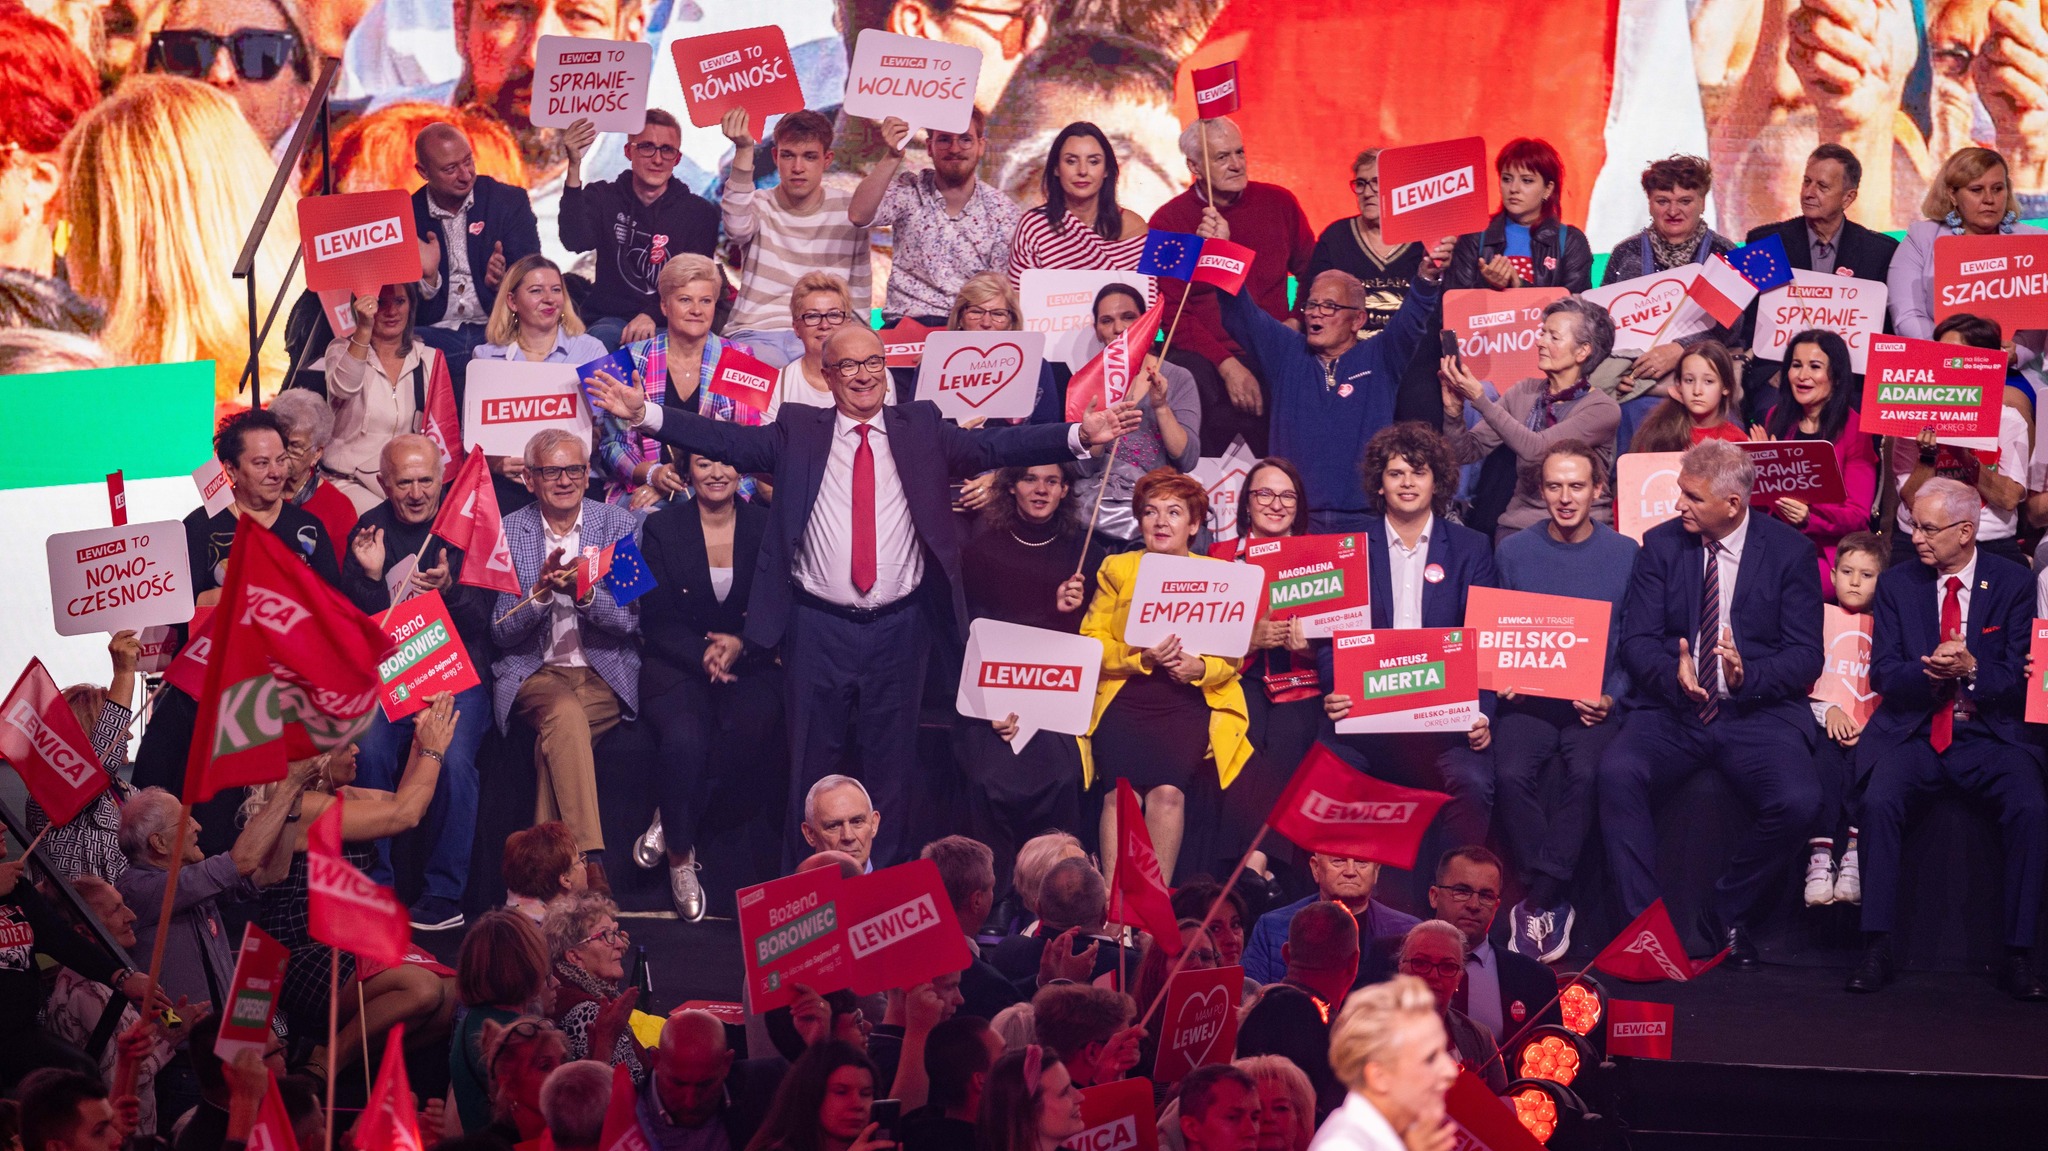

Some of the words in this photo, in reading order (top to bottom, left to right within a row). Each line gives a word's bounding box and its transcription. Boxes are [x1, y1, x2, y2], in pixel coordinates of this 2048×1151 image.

[561, 52, 600, 64] LEWICA
[608, 50, 625, 62] TO
[703, 54, 740, 70] LEWICA
[744, 45, 763, 59] TO
[882, 56, 925, 68] LEWICA
[932, 58, 951, 71] TO
[549, 70, 635, 93] SPRAWIE-
[690, 57, 787, 103] RÓWNOŚĆ
[858, 77, 966, 100] WOLNOŚĆ
[1200, 83, 1233, 101] LEWICA
[1398, 173, 1469, 209] LEWICA
[321, 223, 398, 256] LEWICA
[1200, 257, 1240, 272] LEWICA
[1964, 259, 2005, 272] LEWICA
[2013, 254, 2034, 268] TO
[1049, 292, 1090, 305] LEWICA
[1634, 295, 1661, 309] MAM
[1664, 288, 1680, 298] PO
[1789, 287, 1831, 297] LEWICA
[1839, 287, 1858, 299] TO
[1027, 314, 1094, 333] TOLERA
[1472, 313, 1513, 326] LEWICA
[1521, 307, 1541, 320] TO
[1776, 306, 1868, 327] SPRAWIE-
[970, 357, 997, 370] MAM
[1000, 357, 1016, 367] PO
[1954, 358, 1961, 367] 2
[726, 371, 766, 390] LEWICA
[939, 371, 1003, 391] LEWEJ
[1882, 369, 1935, 383] RAFAŁ
[1880, 387, 1978, 402] ADAMCZYK
[487, 397, 573, 420] LEWICA
[1880, 410, 1928, 420] ZAWSZE
[1930, 411, 1937, 420] Z
[1939, 411, 1978, 421] WAMI!
[1936, 423, 1964, 432] OKRĘG
[1784, 448, 1803, 457] TO
[1755, 460, 1822, 478] RAWIE-
[80, 543, 124, 561] LEWICA
[131, 535, 150, 549] TO
[1251, 543, 1278, 555] LEWICA
[1346, 537, 1352, 547] 2
[86, 556, 156, 590] NOWO-
[1278, 561, 1334, 579] MAGDALENA
[67, 571, 176, 616] CZESNOŚĆ
[1163, 582, 1206, 592] LEWICA
[1212, 582, 1229, 593] TO
[1272, 576, 1342, 604] MADZIA
[1139, 601, 1245, 623] EMPATIA
[1314, 611, 1363, 626] BIELSKO-BIAŁA
[391, 613, 426, 643] ożena
[1453, 632, 1460, 641] 7
[1340, 636, 1372, 648] LEWICA
[1478, 631, 1589, 649] BIELSKO-
[380, 625, 446, 679] BOROWIEC
[1380, 653, 1428, 668] MATEUSZ
[1498, 651, 1567, 669] BIAŁA
[1825, 653, 1871, 678] LEW
[399, 686, 407, 697] 3
[428, 669, 436, 677] do
[435, 658, 452, 672] Sejmu
[984, 666, 1075, 688] LEWICA
[1368, 668, 1440, 693] MERTA
[1414, 706, 1471, 720] BIELSKO-BIAŁA
[1424, 718, 1449, 728] OKRĘG
[1450, 716, 1461, 724] NR
[13, 704, 86, 783] LEWICA
[1309, 795, 1408, 822] LEWICA
[769, 891, 818, 927] Bożena
[758, 908, 834, 961] BOROWIEC
[852, 901, 934, 952] LEWICA
[771, 974, 777, 987] 3
[1195, 1007, 1213, 1021] MAM
[1214, 1003, 1224, 1015] PO
[1173, 1020, 1216, 1050] LEWEJ
[1616, 1024, 1663, 1035] LEWICA
